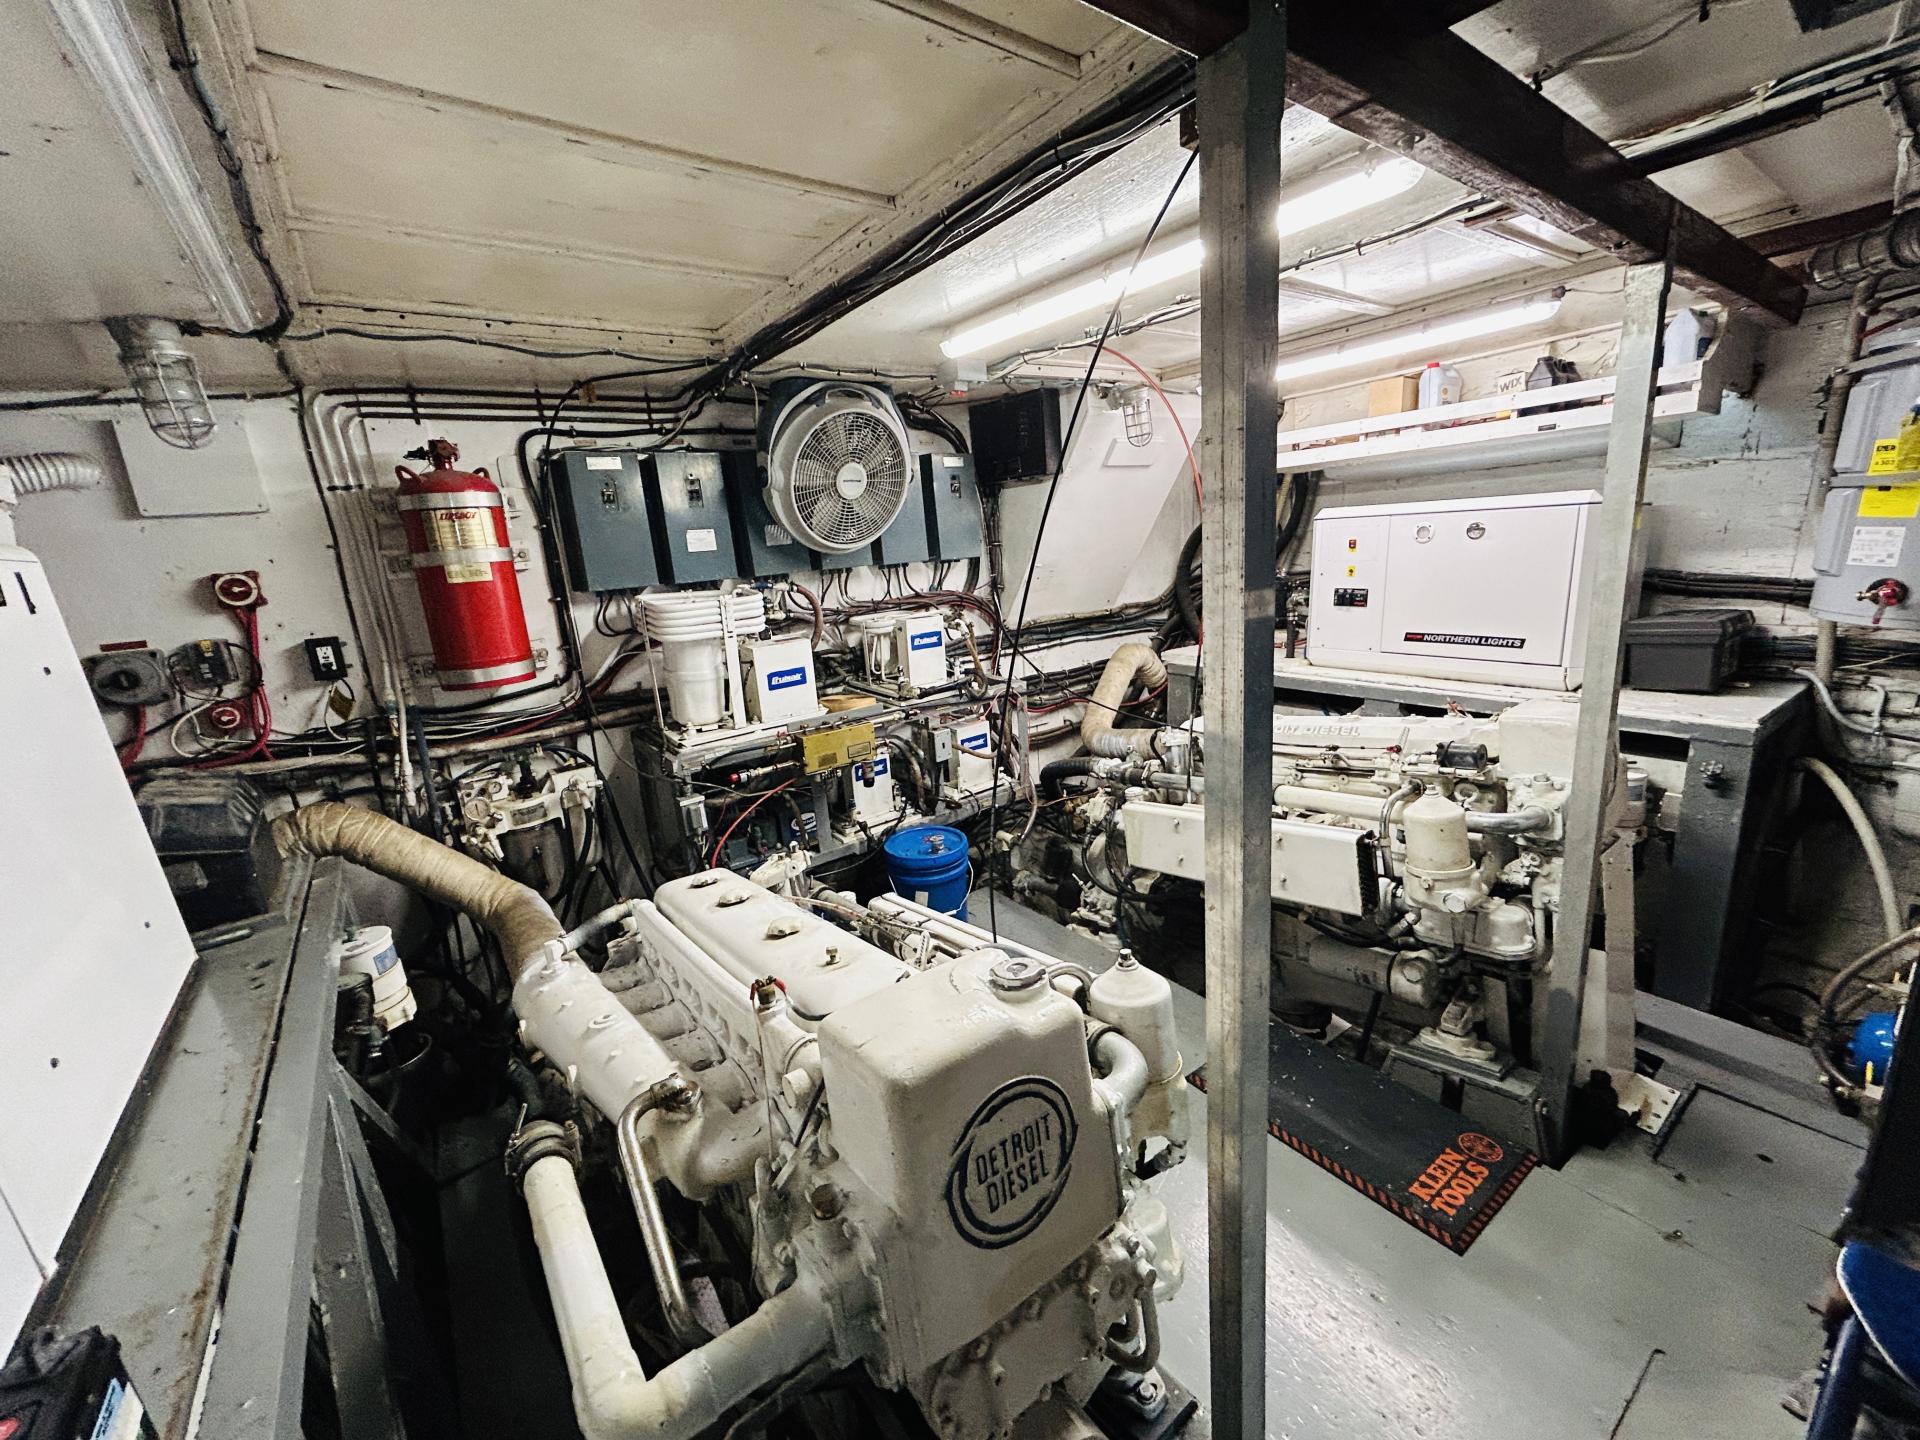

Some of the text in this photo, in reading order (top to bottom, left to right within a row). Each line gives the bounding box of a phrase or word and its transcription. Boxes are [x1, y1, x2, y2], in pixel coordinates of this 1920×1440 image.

[1500, 376, 1523, 392] WIX
[1423, 634, 1480, 645] NORTHERN
[1480, 637, 1521, 647] LIGHTS
[1302, 725, 1361, 737] DIESEL
[975, 1112, 1051, 1185] DETROIT
[1408, 1147, 1468, 1202] KLEIN
[986, 1150, 1050, 1213] DIESEL
[1431, 1161, 1489, 1217] TOOLS
